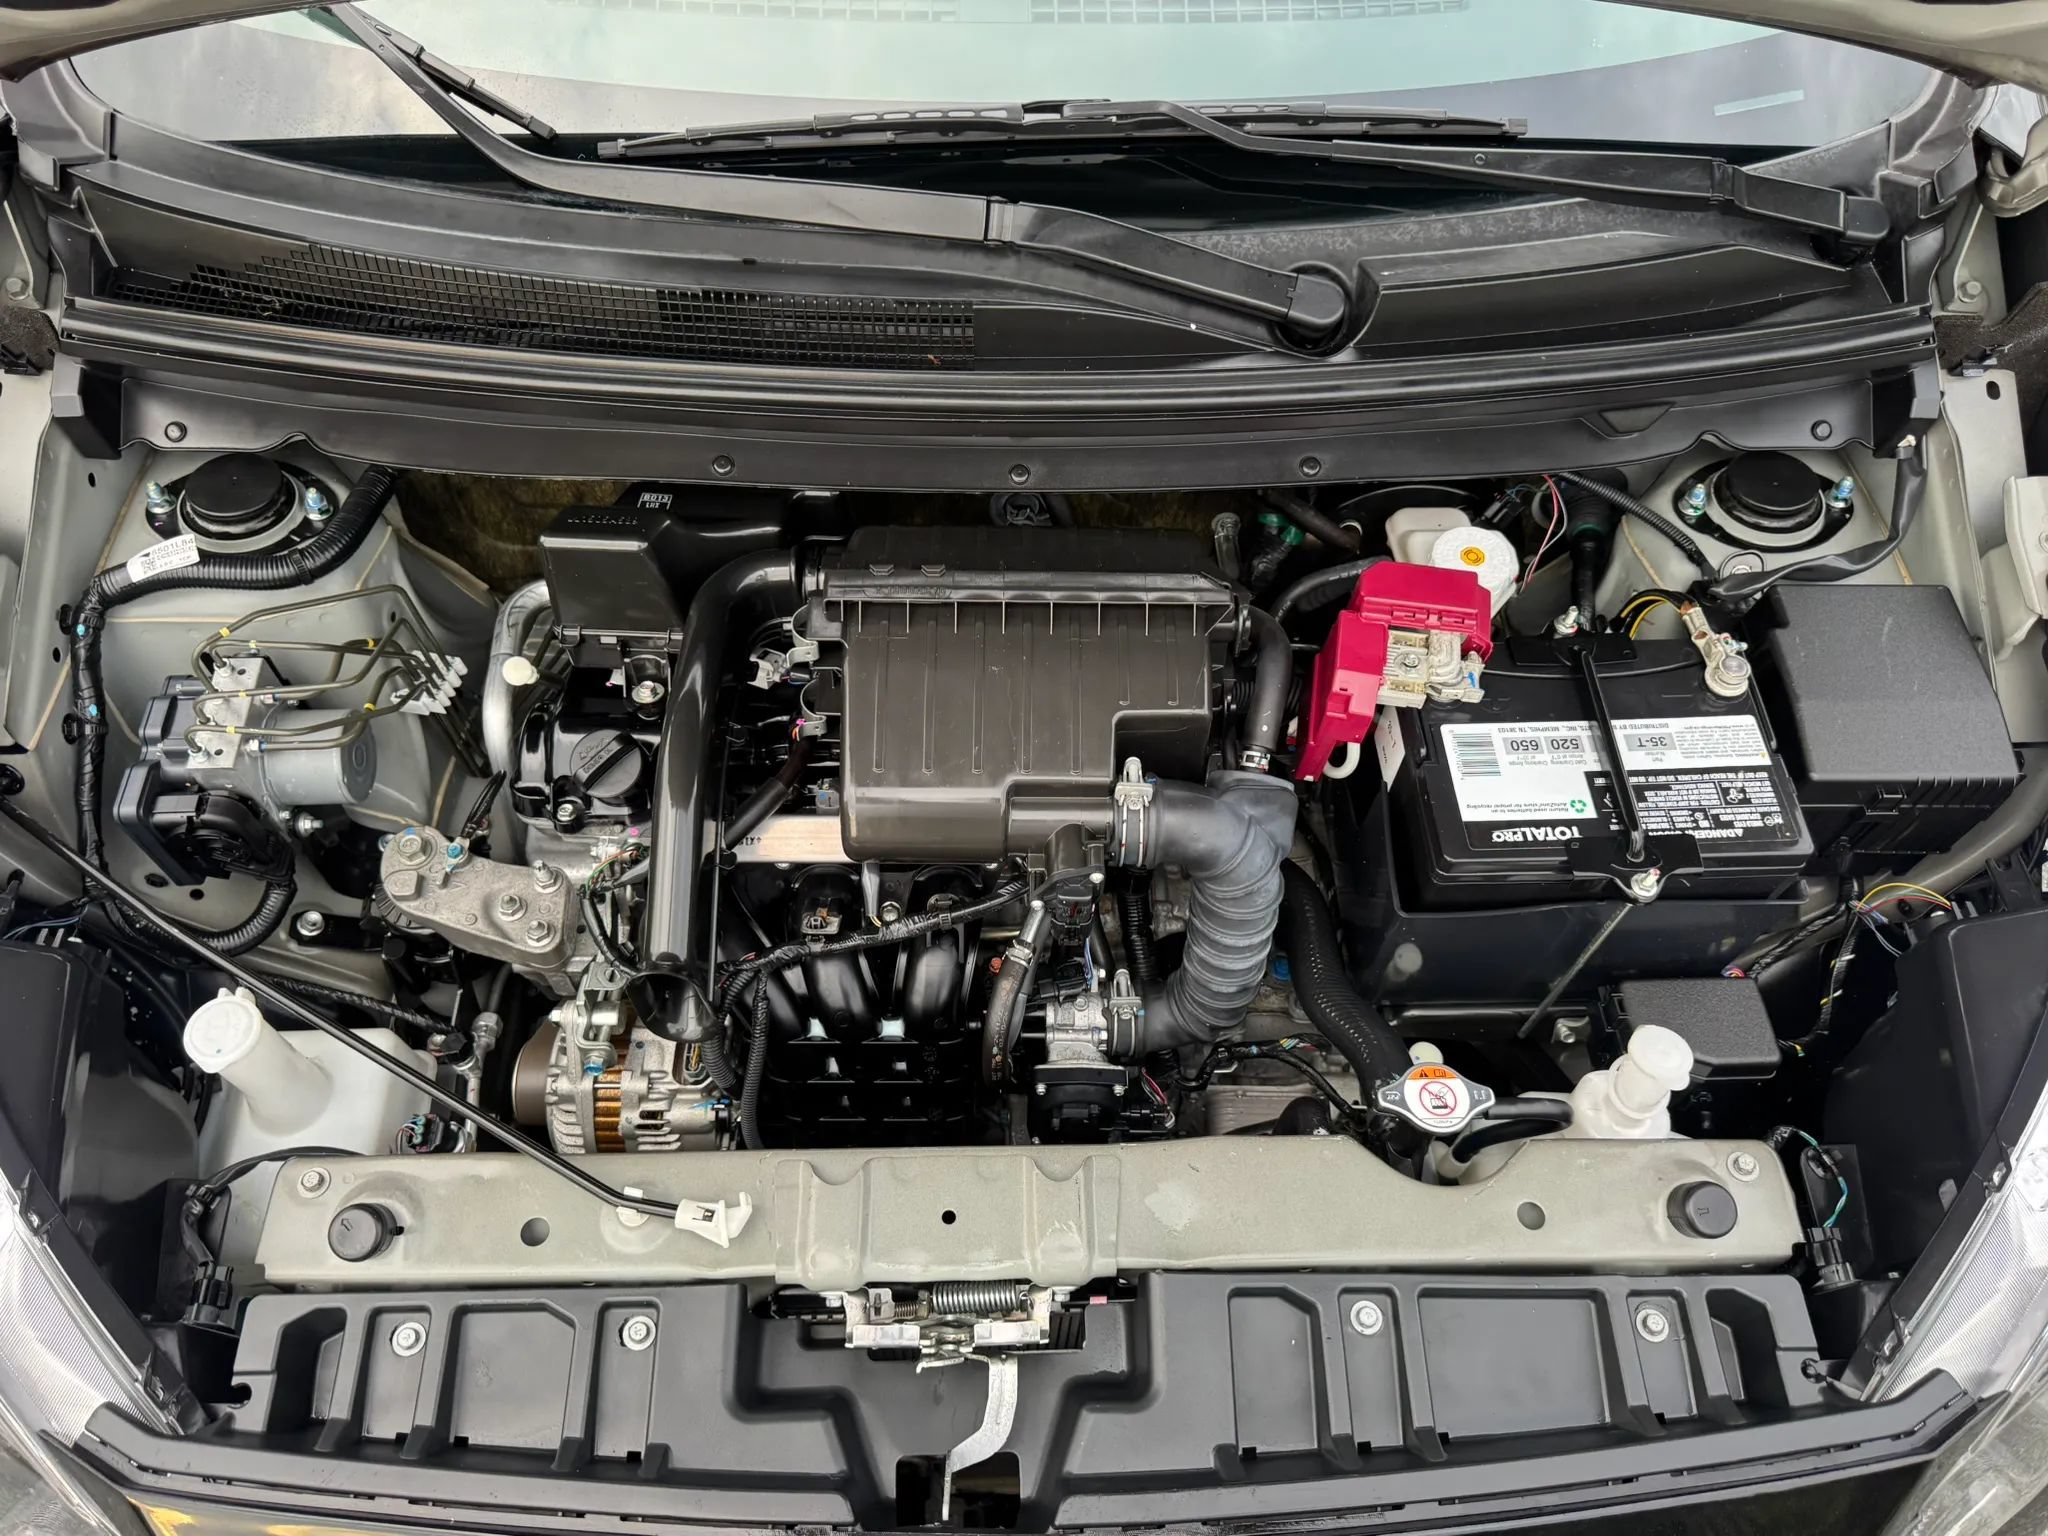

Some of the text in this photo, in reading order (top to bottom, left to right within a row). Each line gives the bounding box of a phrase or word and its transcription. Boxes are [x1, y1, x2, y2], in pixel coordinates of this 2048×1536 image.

[1510, 739, 1539, 752] 650
[1550, 738, 1580, 750] 520
[1637, 736, 1668, 748] 35-T
[1492, 825, 1584, 843] TOTALPRO
